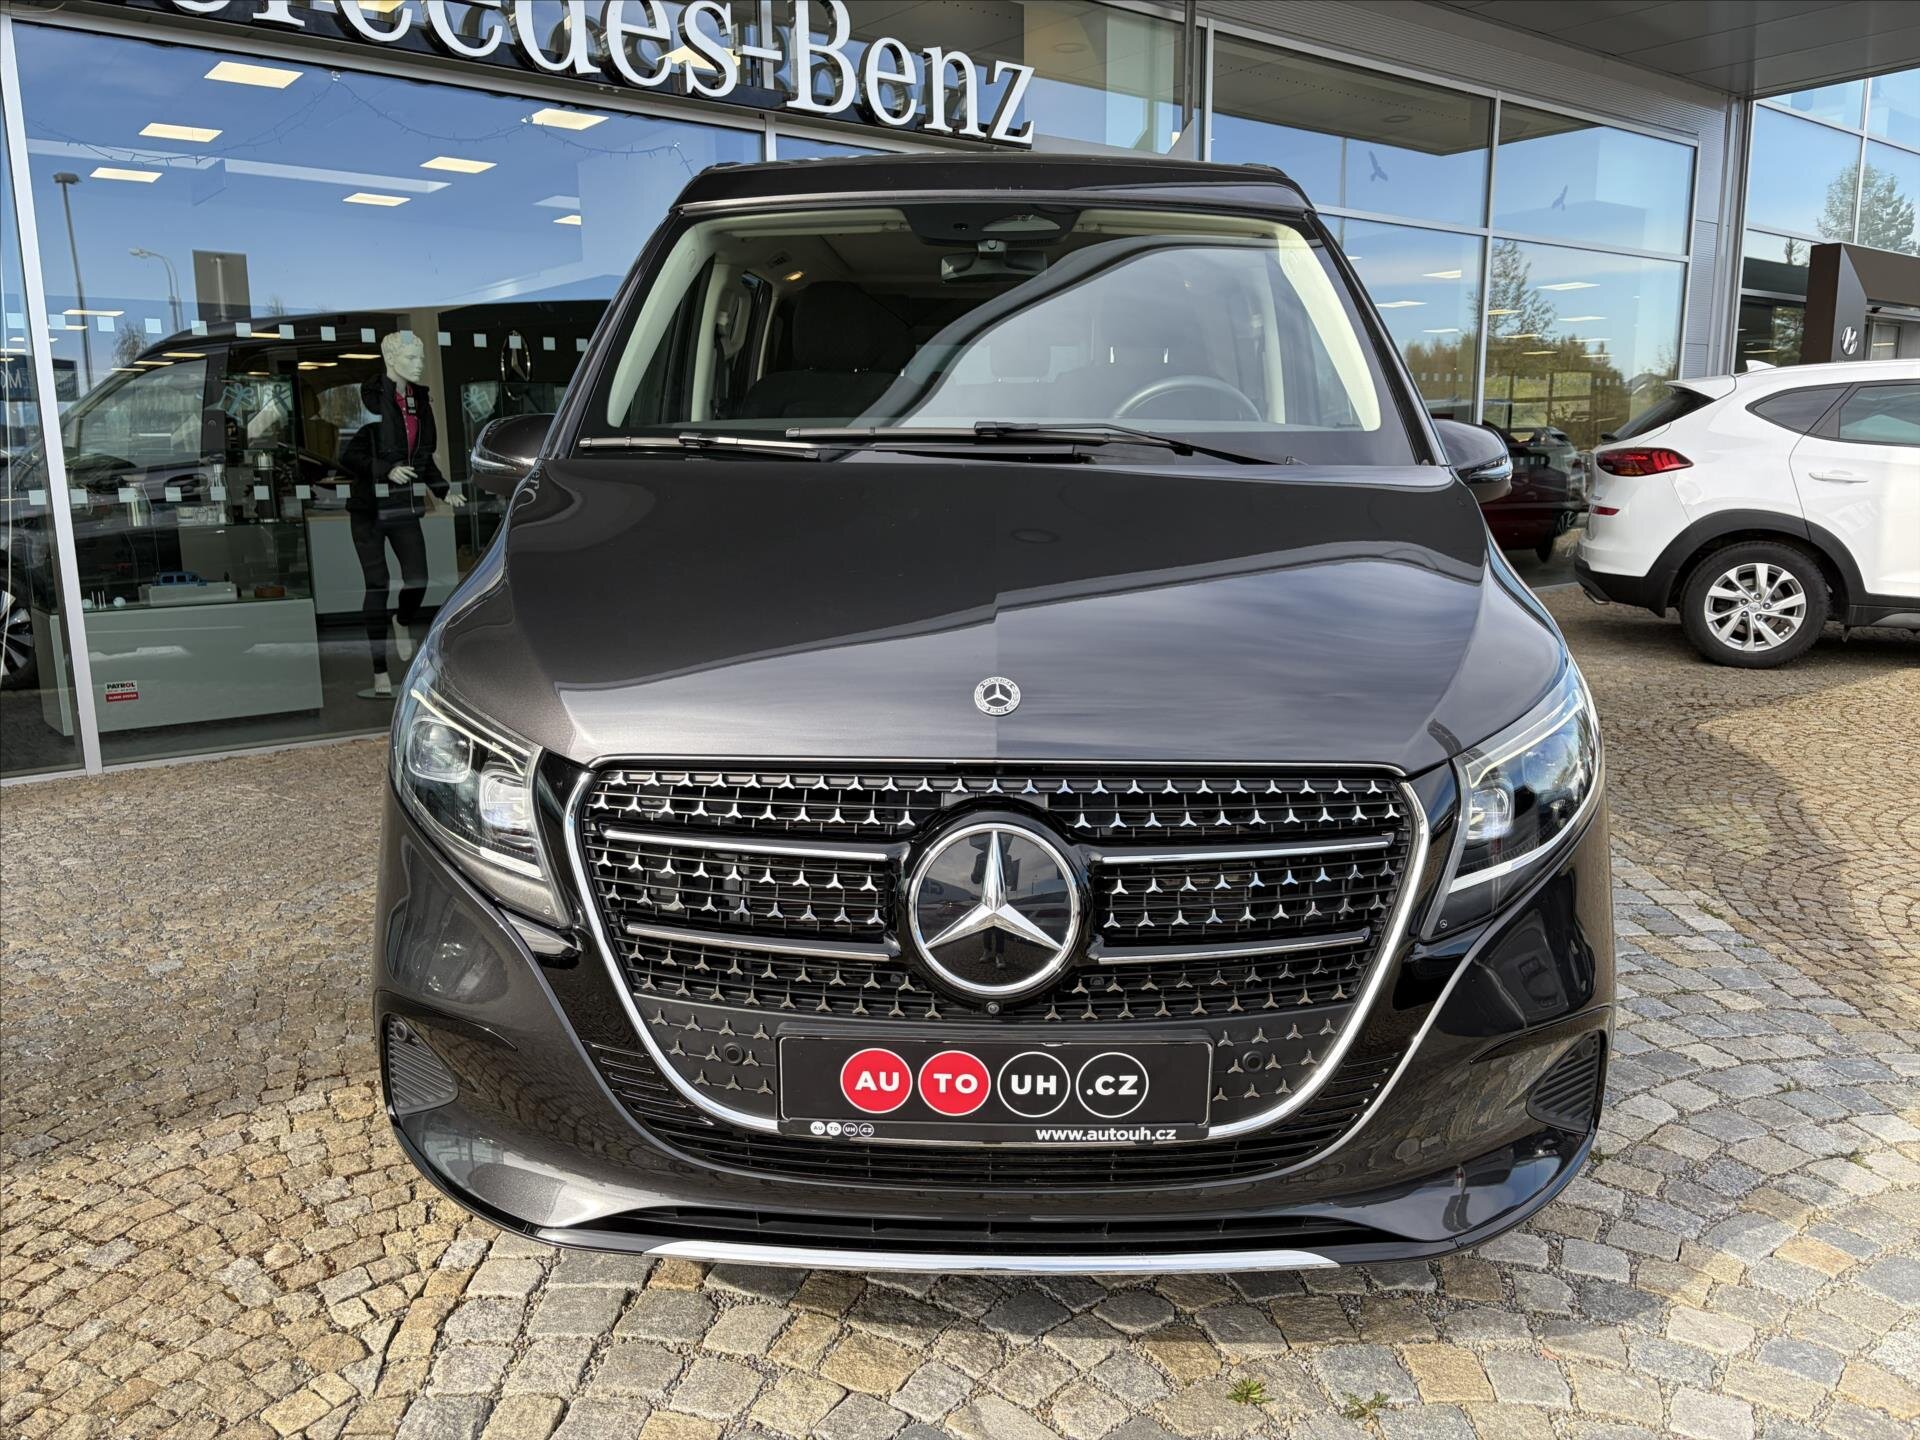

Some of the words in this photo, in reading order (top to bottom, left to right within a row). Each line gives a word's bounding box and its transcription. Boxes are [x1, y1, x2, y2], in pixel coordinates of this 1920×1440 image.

[855, 1071, 899, 1092] AU
[933, 1073, 978, 1094] TO
[1011, 1074, 1057, 1095] UH
[1086, 1075, 1138, 1096] .CZ
[1036, 1127, 1177, 1141] www.autouh.cz
